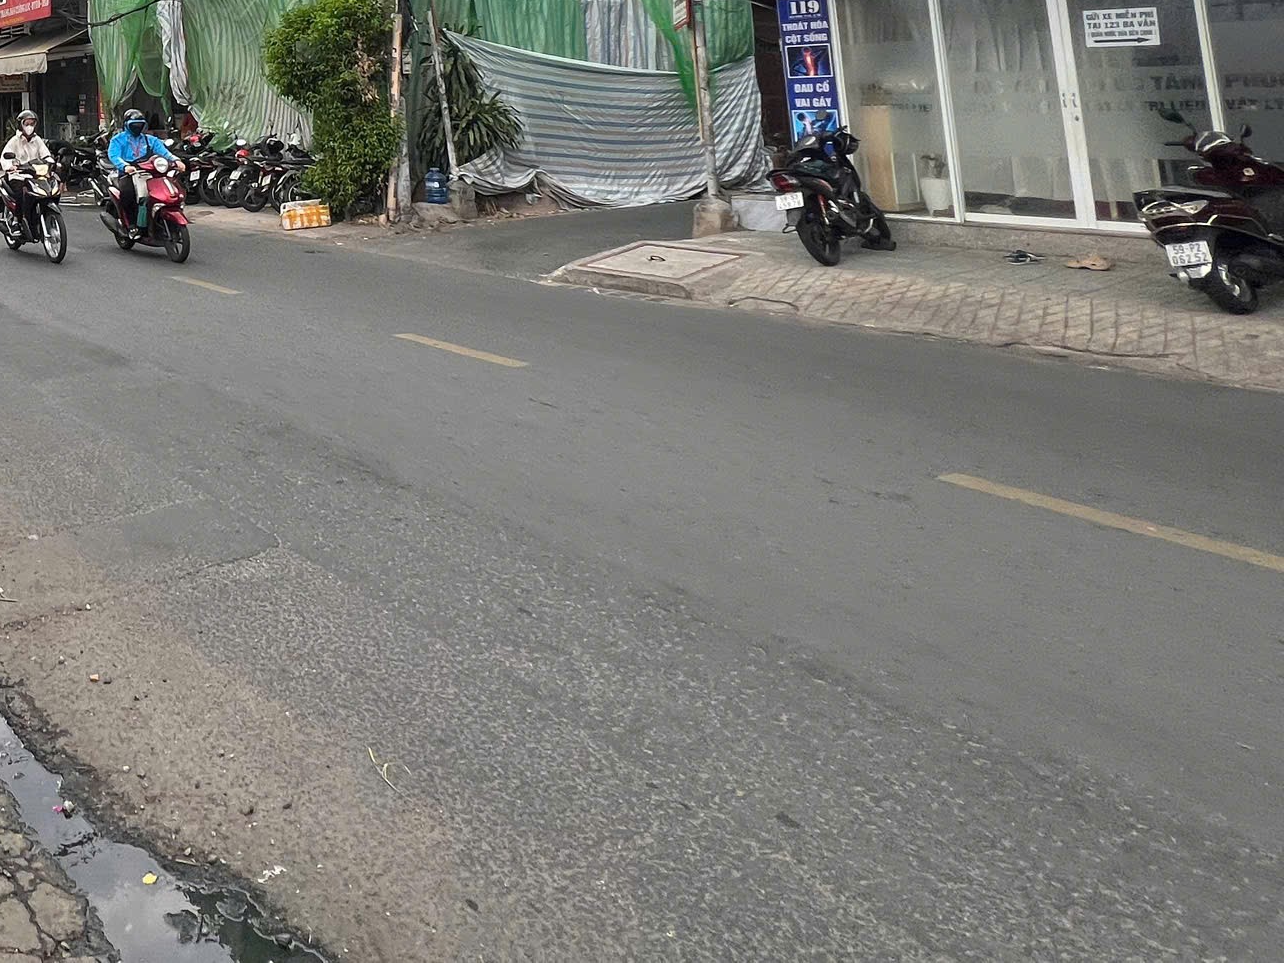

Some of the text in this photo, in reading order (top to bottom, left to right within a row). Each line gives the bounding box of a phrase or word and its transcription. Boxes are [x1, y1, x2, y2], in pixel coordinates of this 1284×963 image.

[788, 0, 821, 16] 119
[1102, 11, 1113, 20] XE
[1122, 20, 1135, 29] BA
[794, 97, 811, 108] VAI
